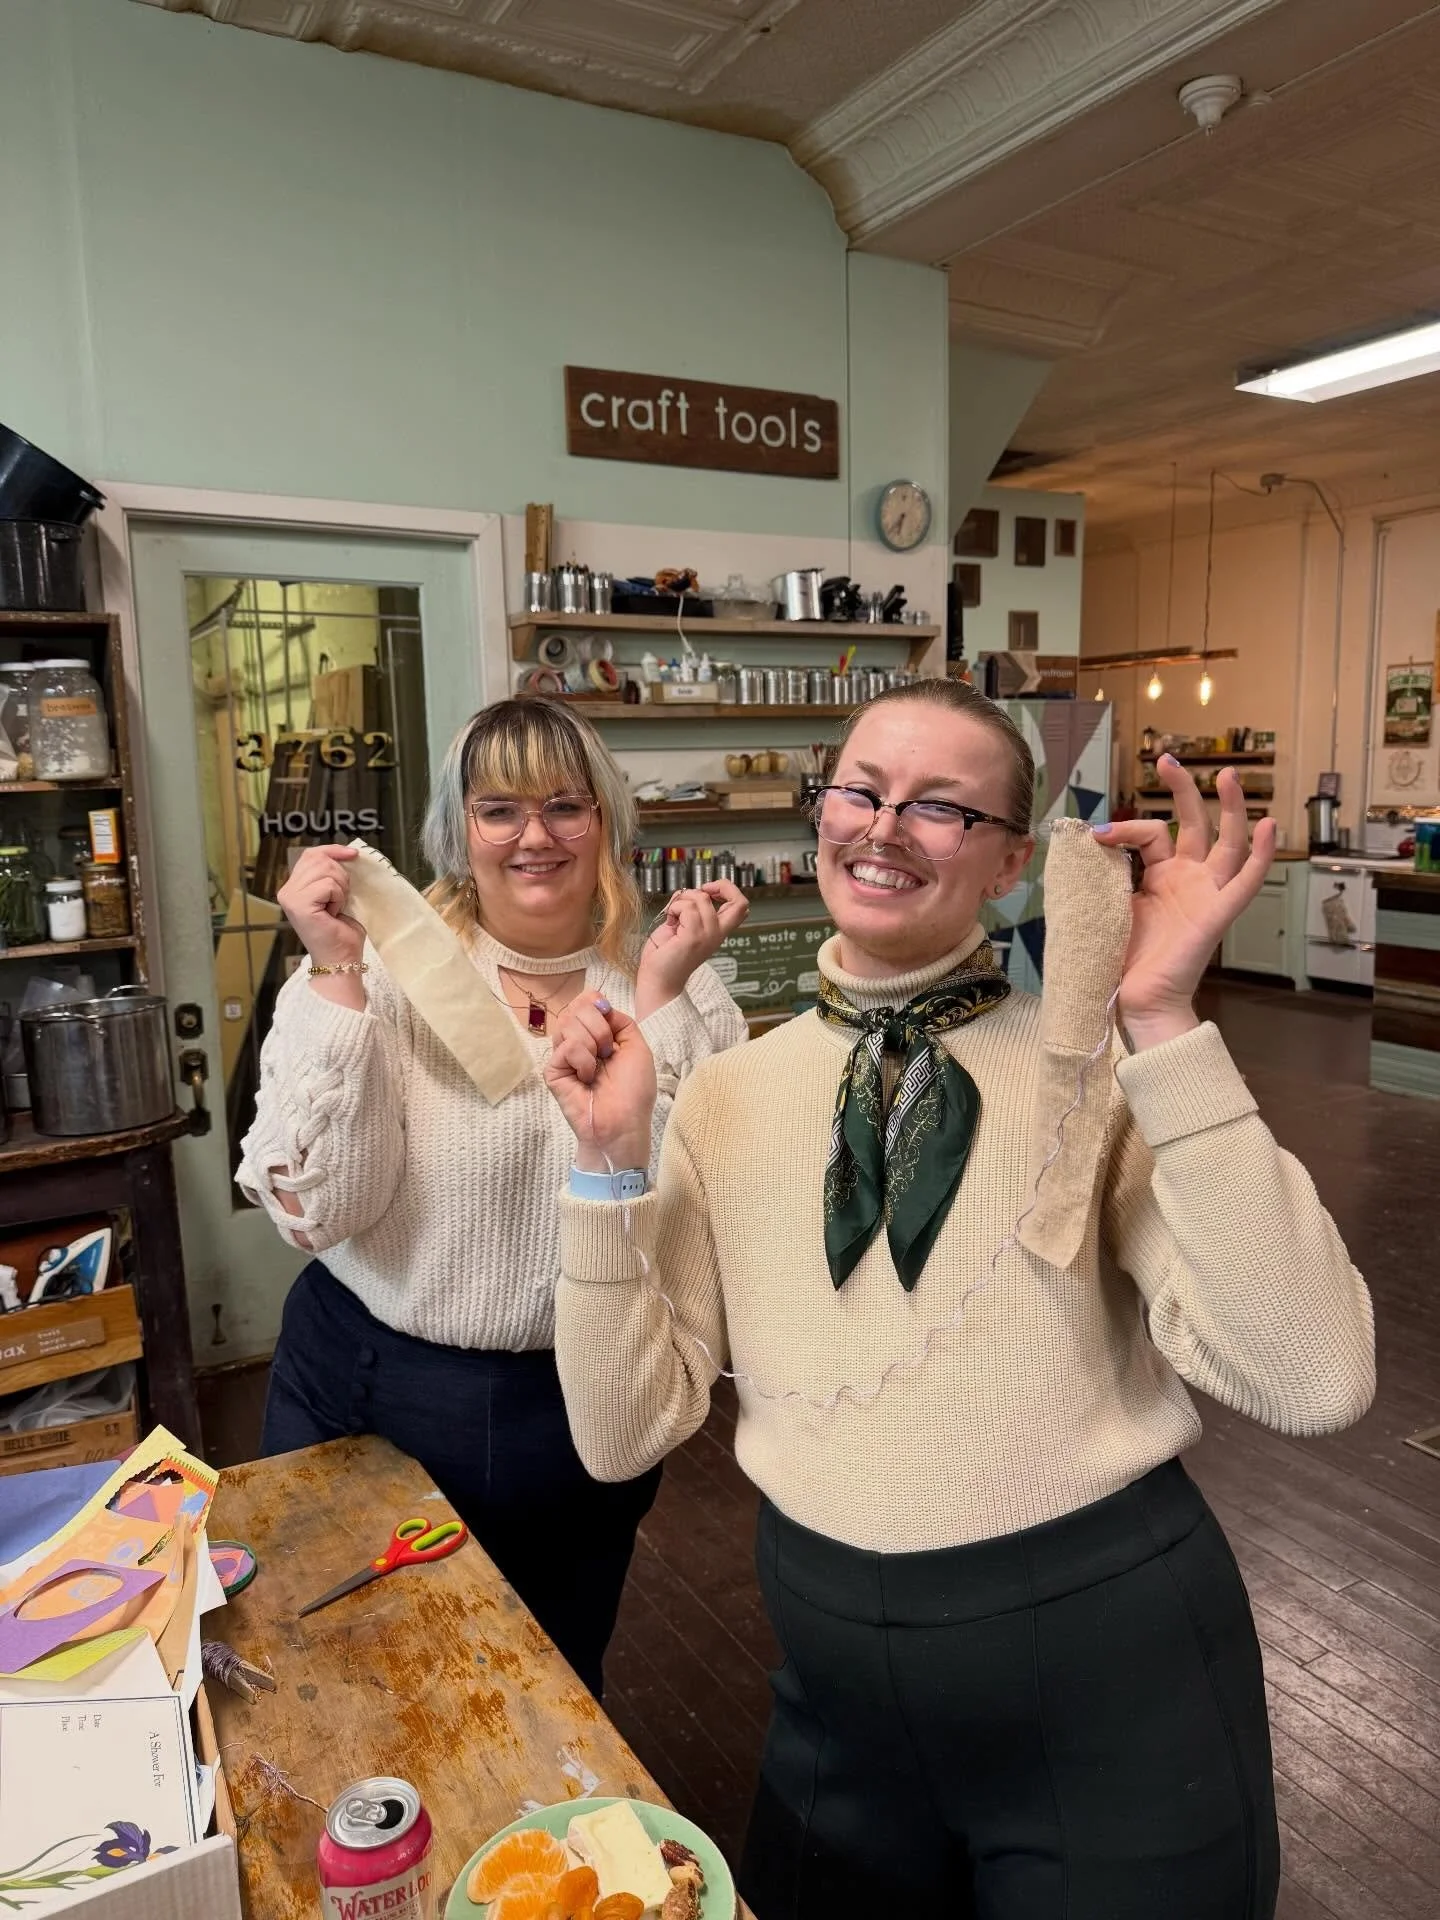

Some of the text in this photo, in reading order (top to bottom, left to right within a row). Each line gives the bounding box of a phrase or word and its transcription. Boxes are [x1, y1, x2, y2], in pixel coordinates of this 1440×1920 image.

[580, 389, 823, 454] craft tools
[236, 731, 400, 773] 3762
[758, 928, 797, 943] waste
[0, 1343, 26, 1360] ax
[150, 1741, 161, 1772] Shower
[153, 1773, 165, 1788] For
